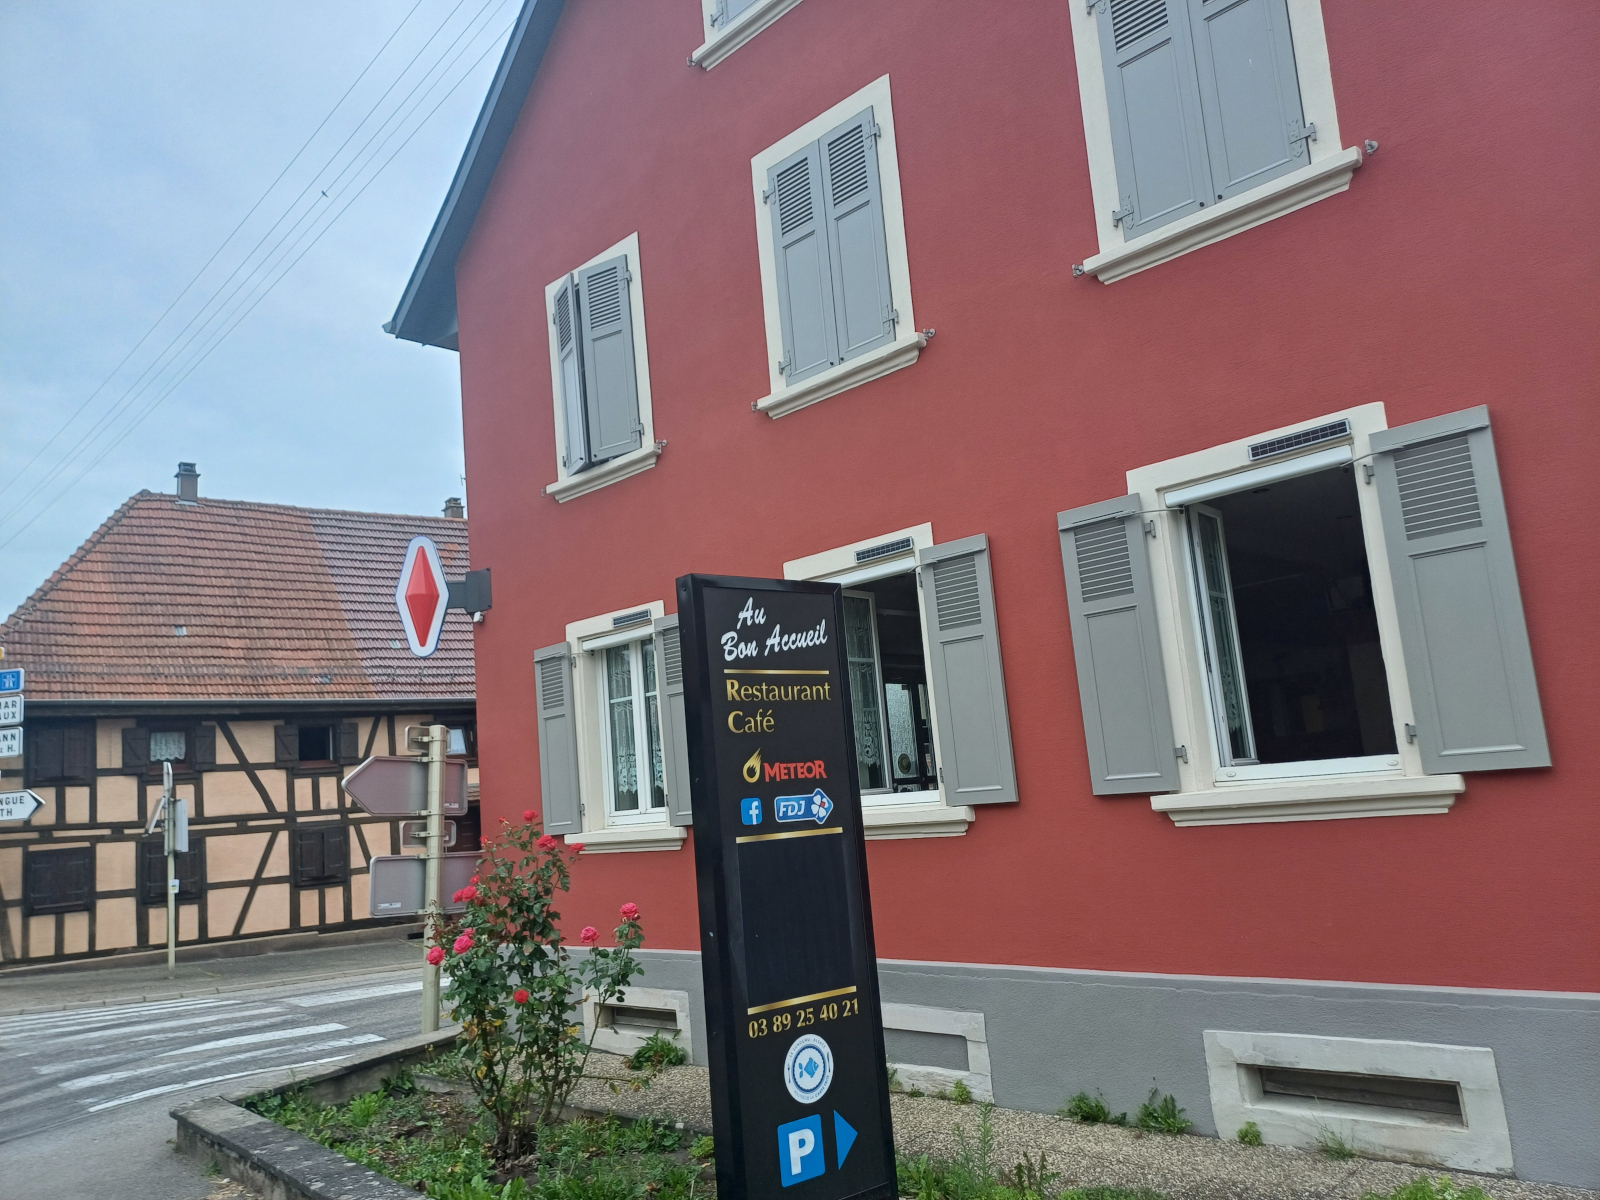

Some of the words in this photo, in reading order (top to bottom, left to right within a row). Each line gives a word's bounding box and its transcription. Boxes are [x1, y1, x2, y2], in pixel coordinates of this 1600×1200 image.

[737, 596, 766, 629] Au
[721, 631, 758, 661] Bon
[764, 619, 828, 656] Accueil
[726, 679, 831, 702] Restaurant
[727, 708, 775, 733] Café
[764, 760, 827, 782] METEOR
[779, 800, 806, 817] FDJ
[749, 1018, 768, 1038] 03
[773, 1012, 792, 1033] 89
[796, 1007, 814, 1028] 25
[820, 1002, 838, 1022] 40
[842, 998, 859, 1018] 21
[788, 1128, 815, 1176] P
